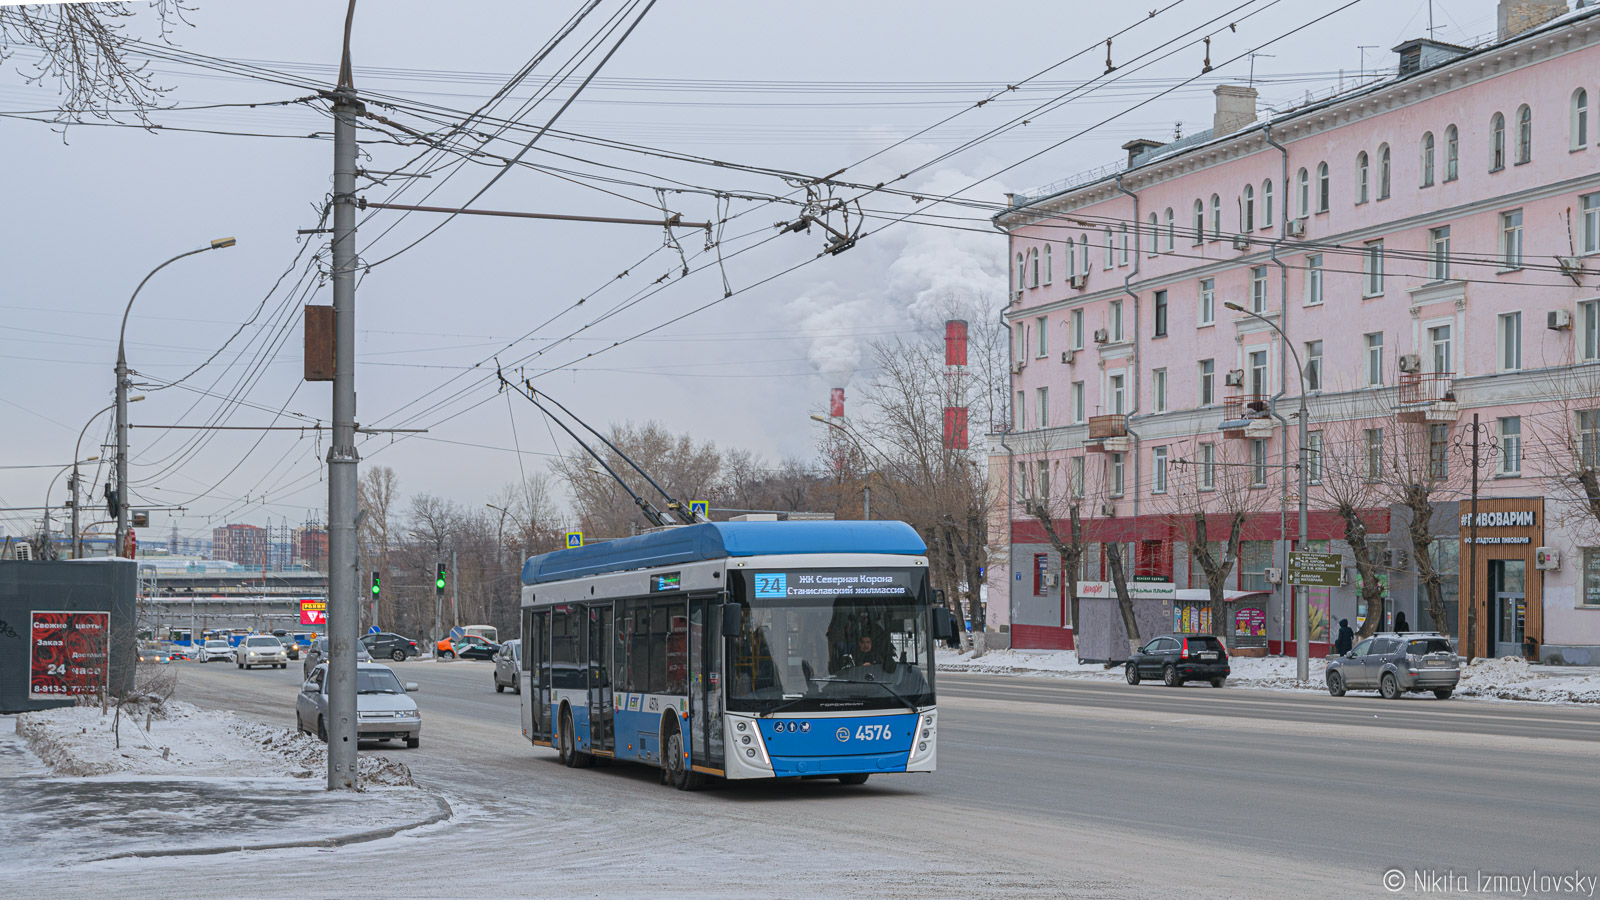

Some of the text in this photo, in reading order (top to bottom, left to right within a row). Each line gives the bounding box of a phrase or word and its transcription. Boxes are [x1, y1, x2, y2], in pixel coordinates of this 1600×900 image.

[760, 577, 782, 593] 24
[799, 574, 893, 585] ЖК Северная Корона
[787, 585, 905, 595] Станиславский жилмассив
[33, 621, 68, 629] Свежие
[47, 664, 66, 675] 24
[855, 724, 892, 741] 4576
